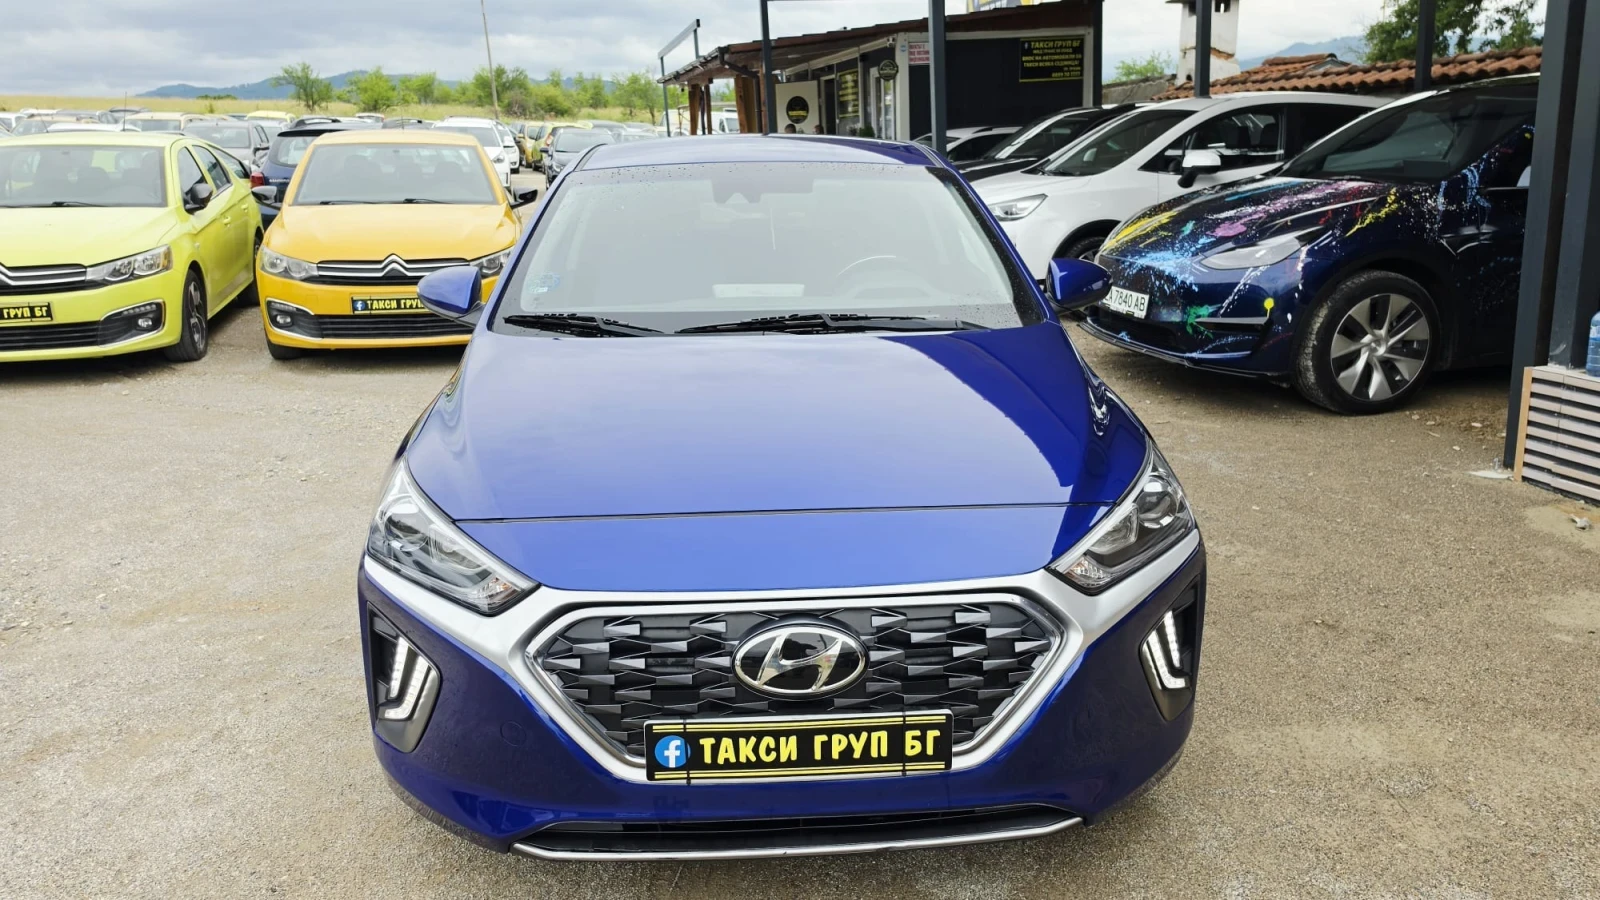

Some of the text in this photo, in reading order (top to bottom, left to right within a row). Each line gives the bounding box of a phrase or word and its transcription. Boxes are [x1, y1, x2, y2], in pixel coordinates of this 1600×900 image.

[1031, 41, 1053, 49] ТАКСИ
[367, 299, 397, 310] ТАКСИ
[1113, 290, 1132, 308] 7840
[1134, 296, 1145, 312] AB
[3, 306, 48, 318] ГРУП БГ
[699, 735, 798, 765] ТАКСИ
[813, 730, 888, 760] ГРУП
[904, 729, 941, 757] БГ
